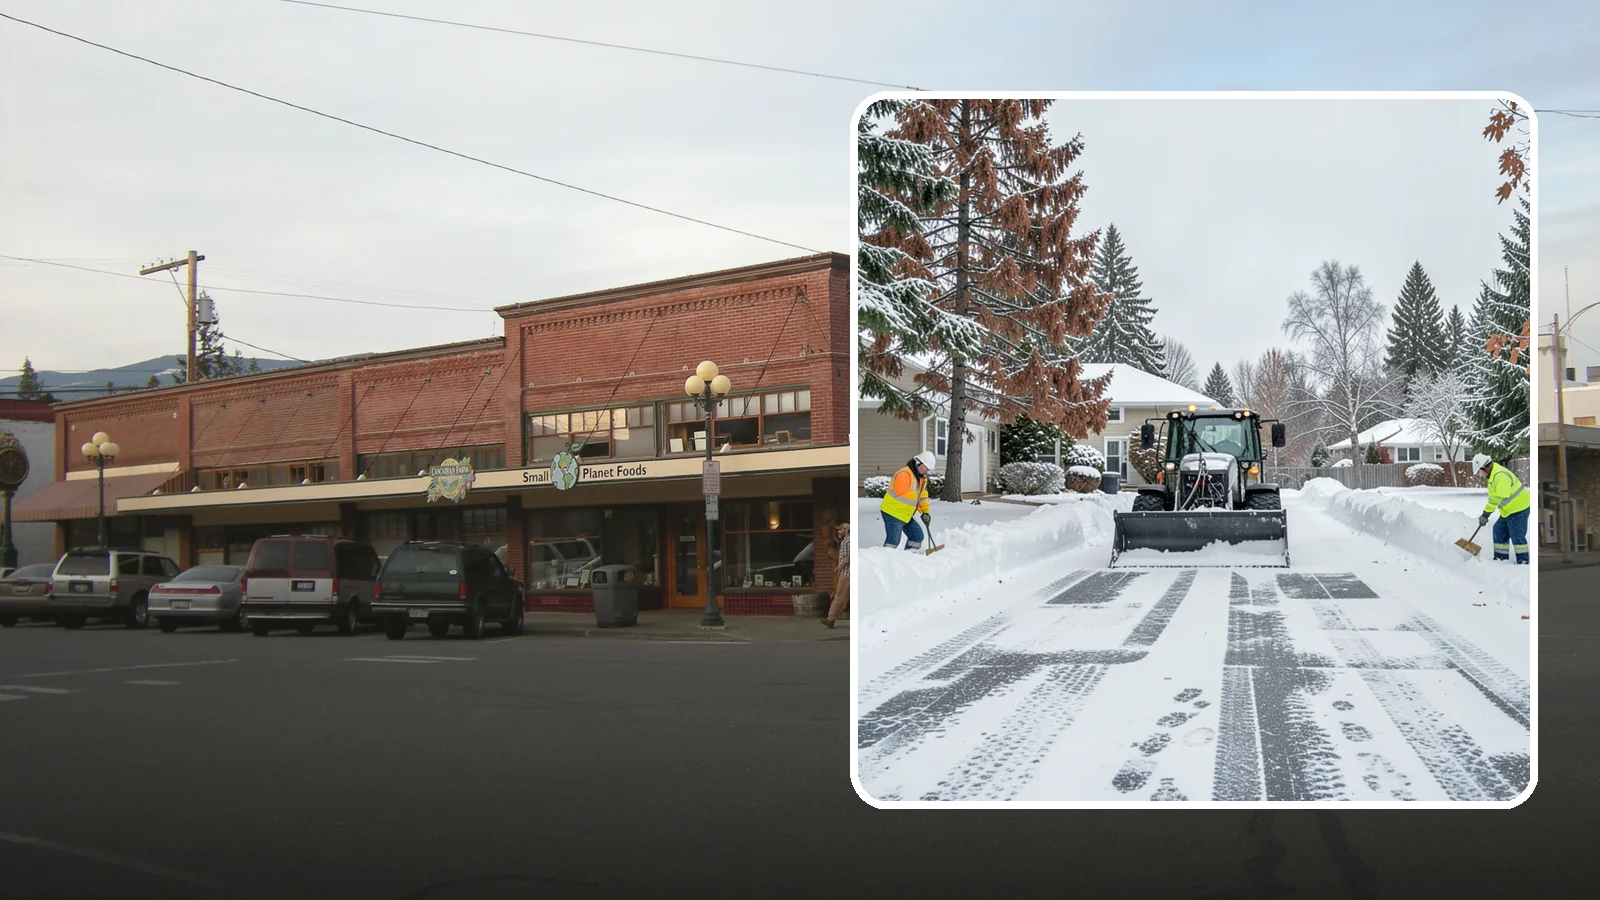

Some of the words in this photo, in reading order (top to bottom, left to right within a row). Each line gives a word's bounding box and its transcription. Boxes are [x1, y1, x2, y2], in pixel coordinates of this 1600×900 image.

[523, 471, 549, 483] Small
[582, 467, 614, 479] Planet
[616, 464, 647, 477] Foods
